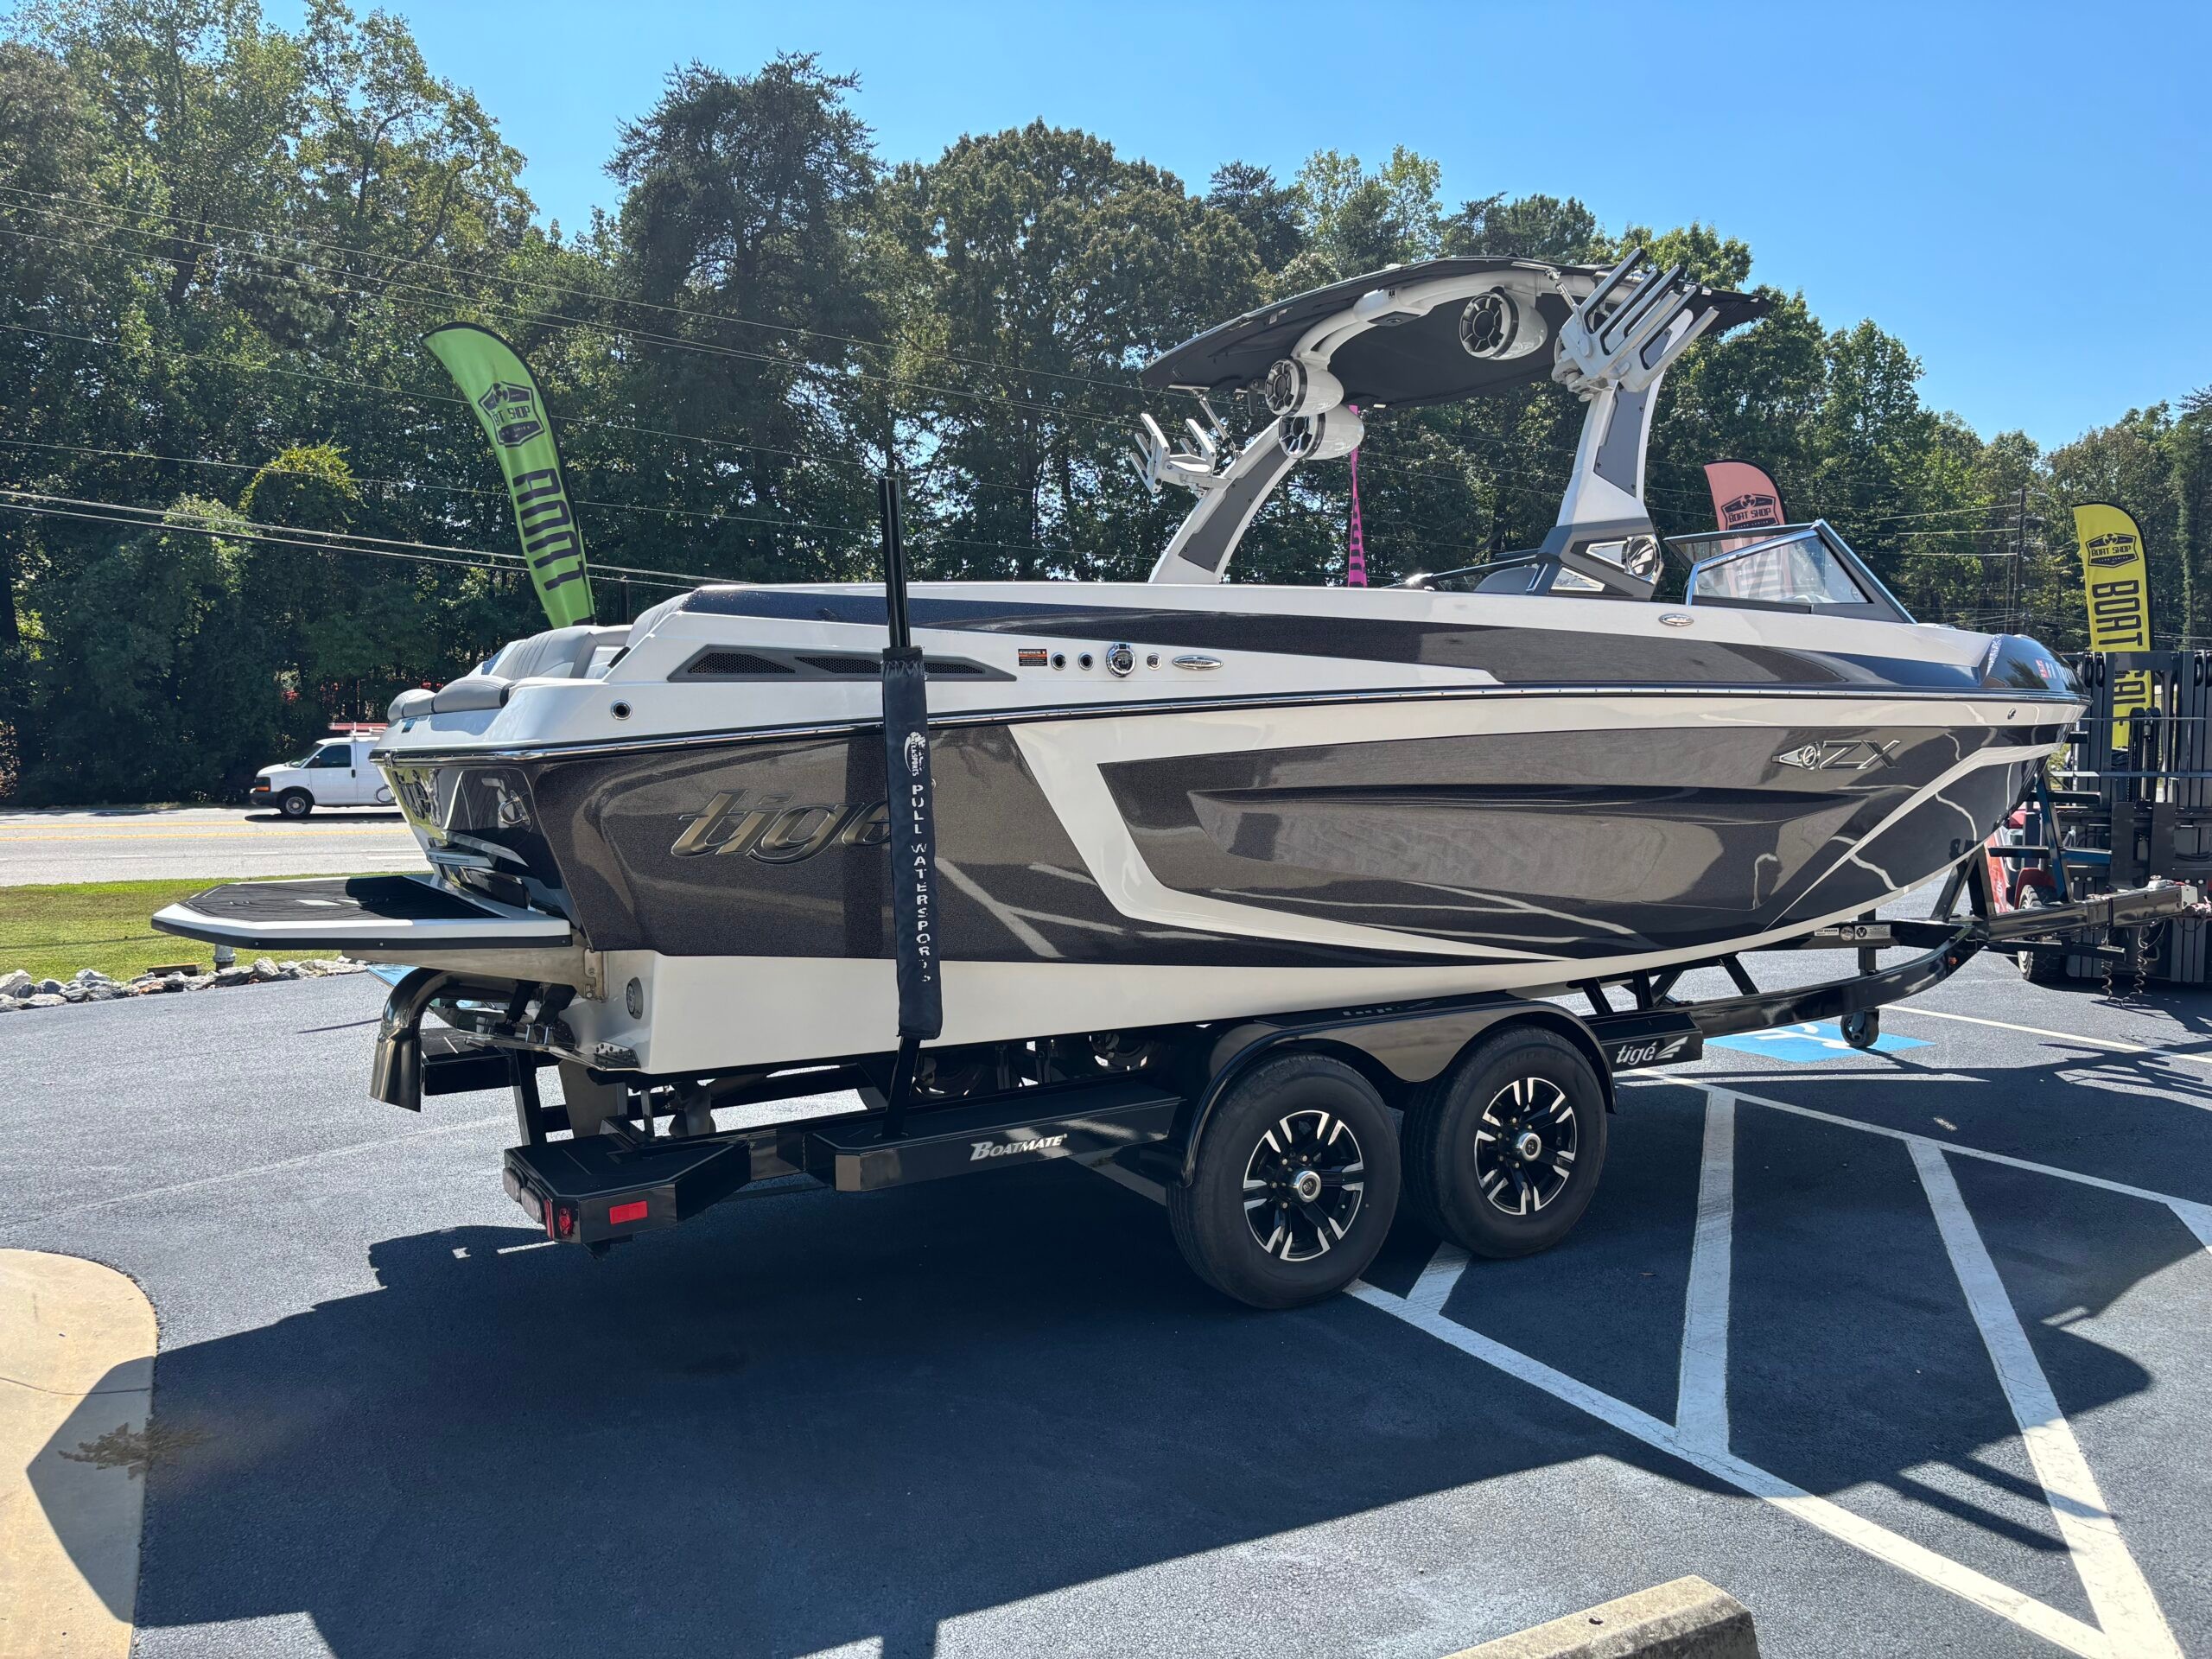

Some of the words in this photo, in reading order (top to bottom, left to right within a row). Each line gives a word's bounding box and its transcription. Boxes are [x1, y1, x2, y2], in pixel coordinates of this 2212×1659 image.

[512, 468, 588, 591] BOAT
[1728, 512, 1749, 523] BOAT
[1751, 507, 1771, 518] SHOP
[2091, 547, 2110, 557] BOAT
[2112, 545, 2132, 554] SHOP
[2091, 579, 2143, 646] BOAT
[911, 784, 925, 835] PULL
[1616, 1040, 1658, 1065] tigé
